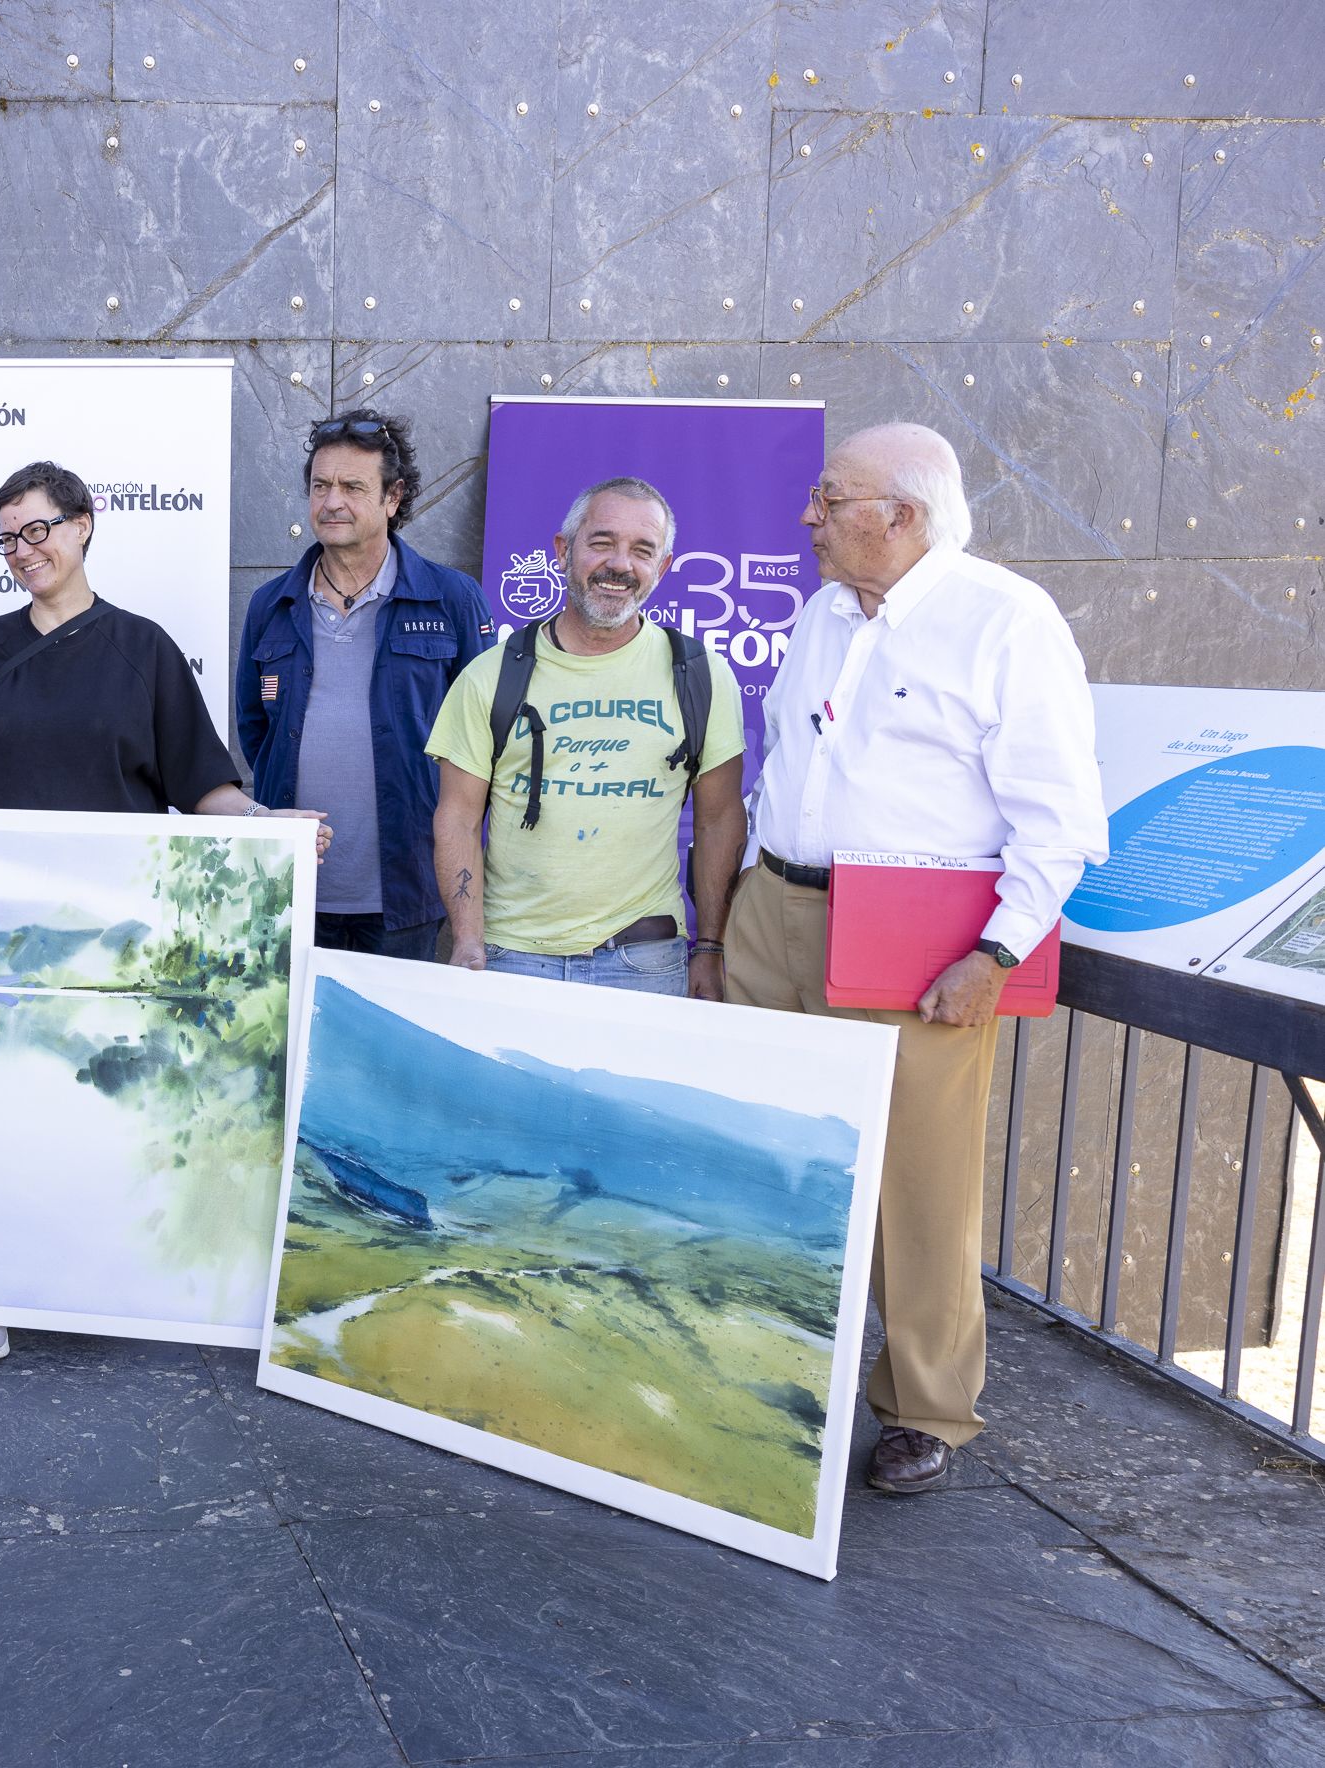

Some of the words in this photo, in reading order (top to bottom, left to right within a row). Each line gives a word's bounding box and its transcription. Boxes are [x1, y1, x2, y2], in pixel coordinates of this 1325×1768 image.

[85, 481, 143, 494] NDACIÓN
[92, 484, 203, 512] ONTELEÓN
[754, 563, 800, 577] AÑOS
[671, 551, 805, 631] 35
[404, 621, 445, 632] HARPER
[549, 699, 675, 737] COUREL
[1200, 729, 1219, 739] Un
[1220, 730, 1249, 742] lago
[551, 735, 631, 757] Parque
[1167, 740, 1184, 749] de
[1184, 741, 1233, 754] leyenda
